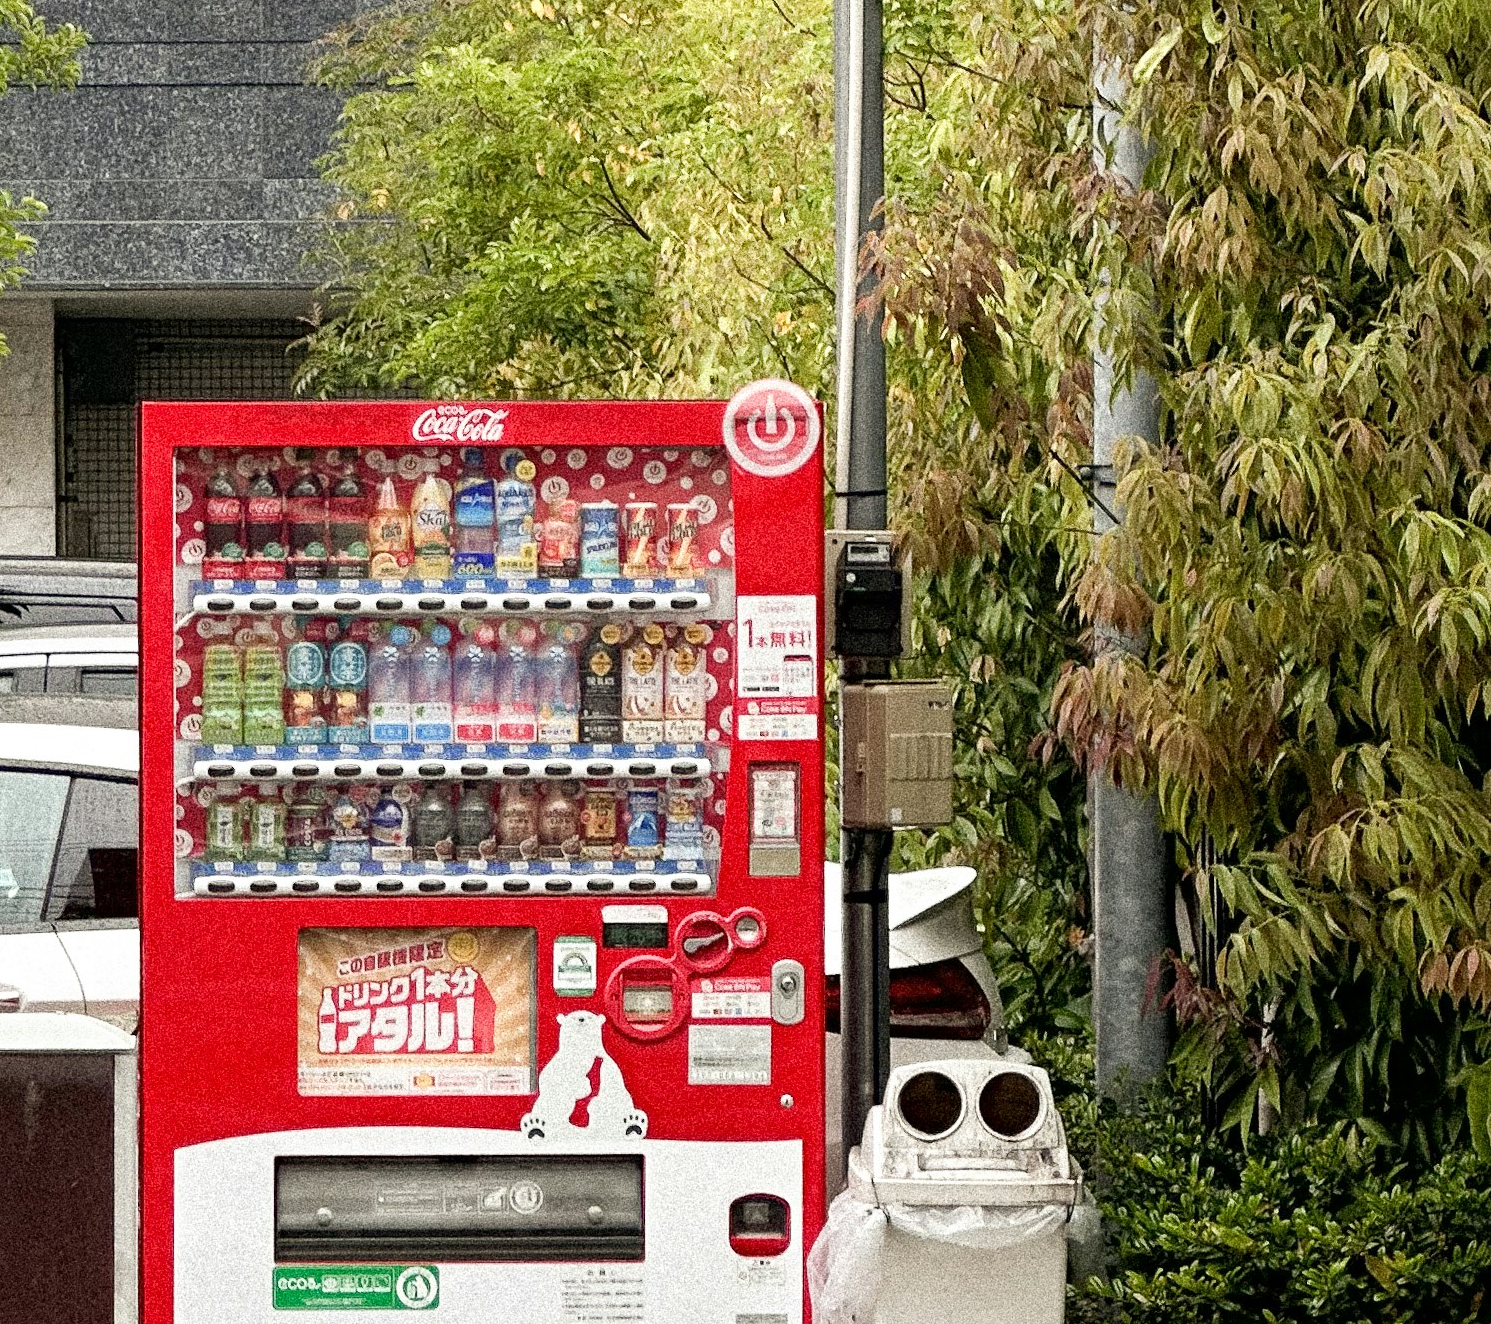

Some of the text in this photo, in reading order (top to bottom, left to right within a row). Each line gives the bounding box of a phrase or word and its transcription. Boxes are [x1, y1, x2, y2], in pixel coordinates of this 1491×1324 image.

[412, 408, 509, 442] Coca-Cola
[338, 966, 478, 1007] ドリンク1本分
[338, 996, 475, 1054] アタル!
